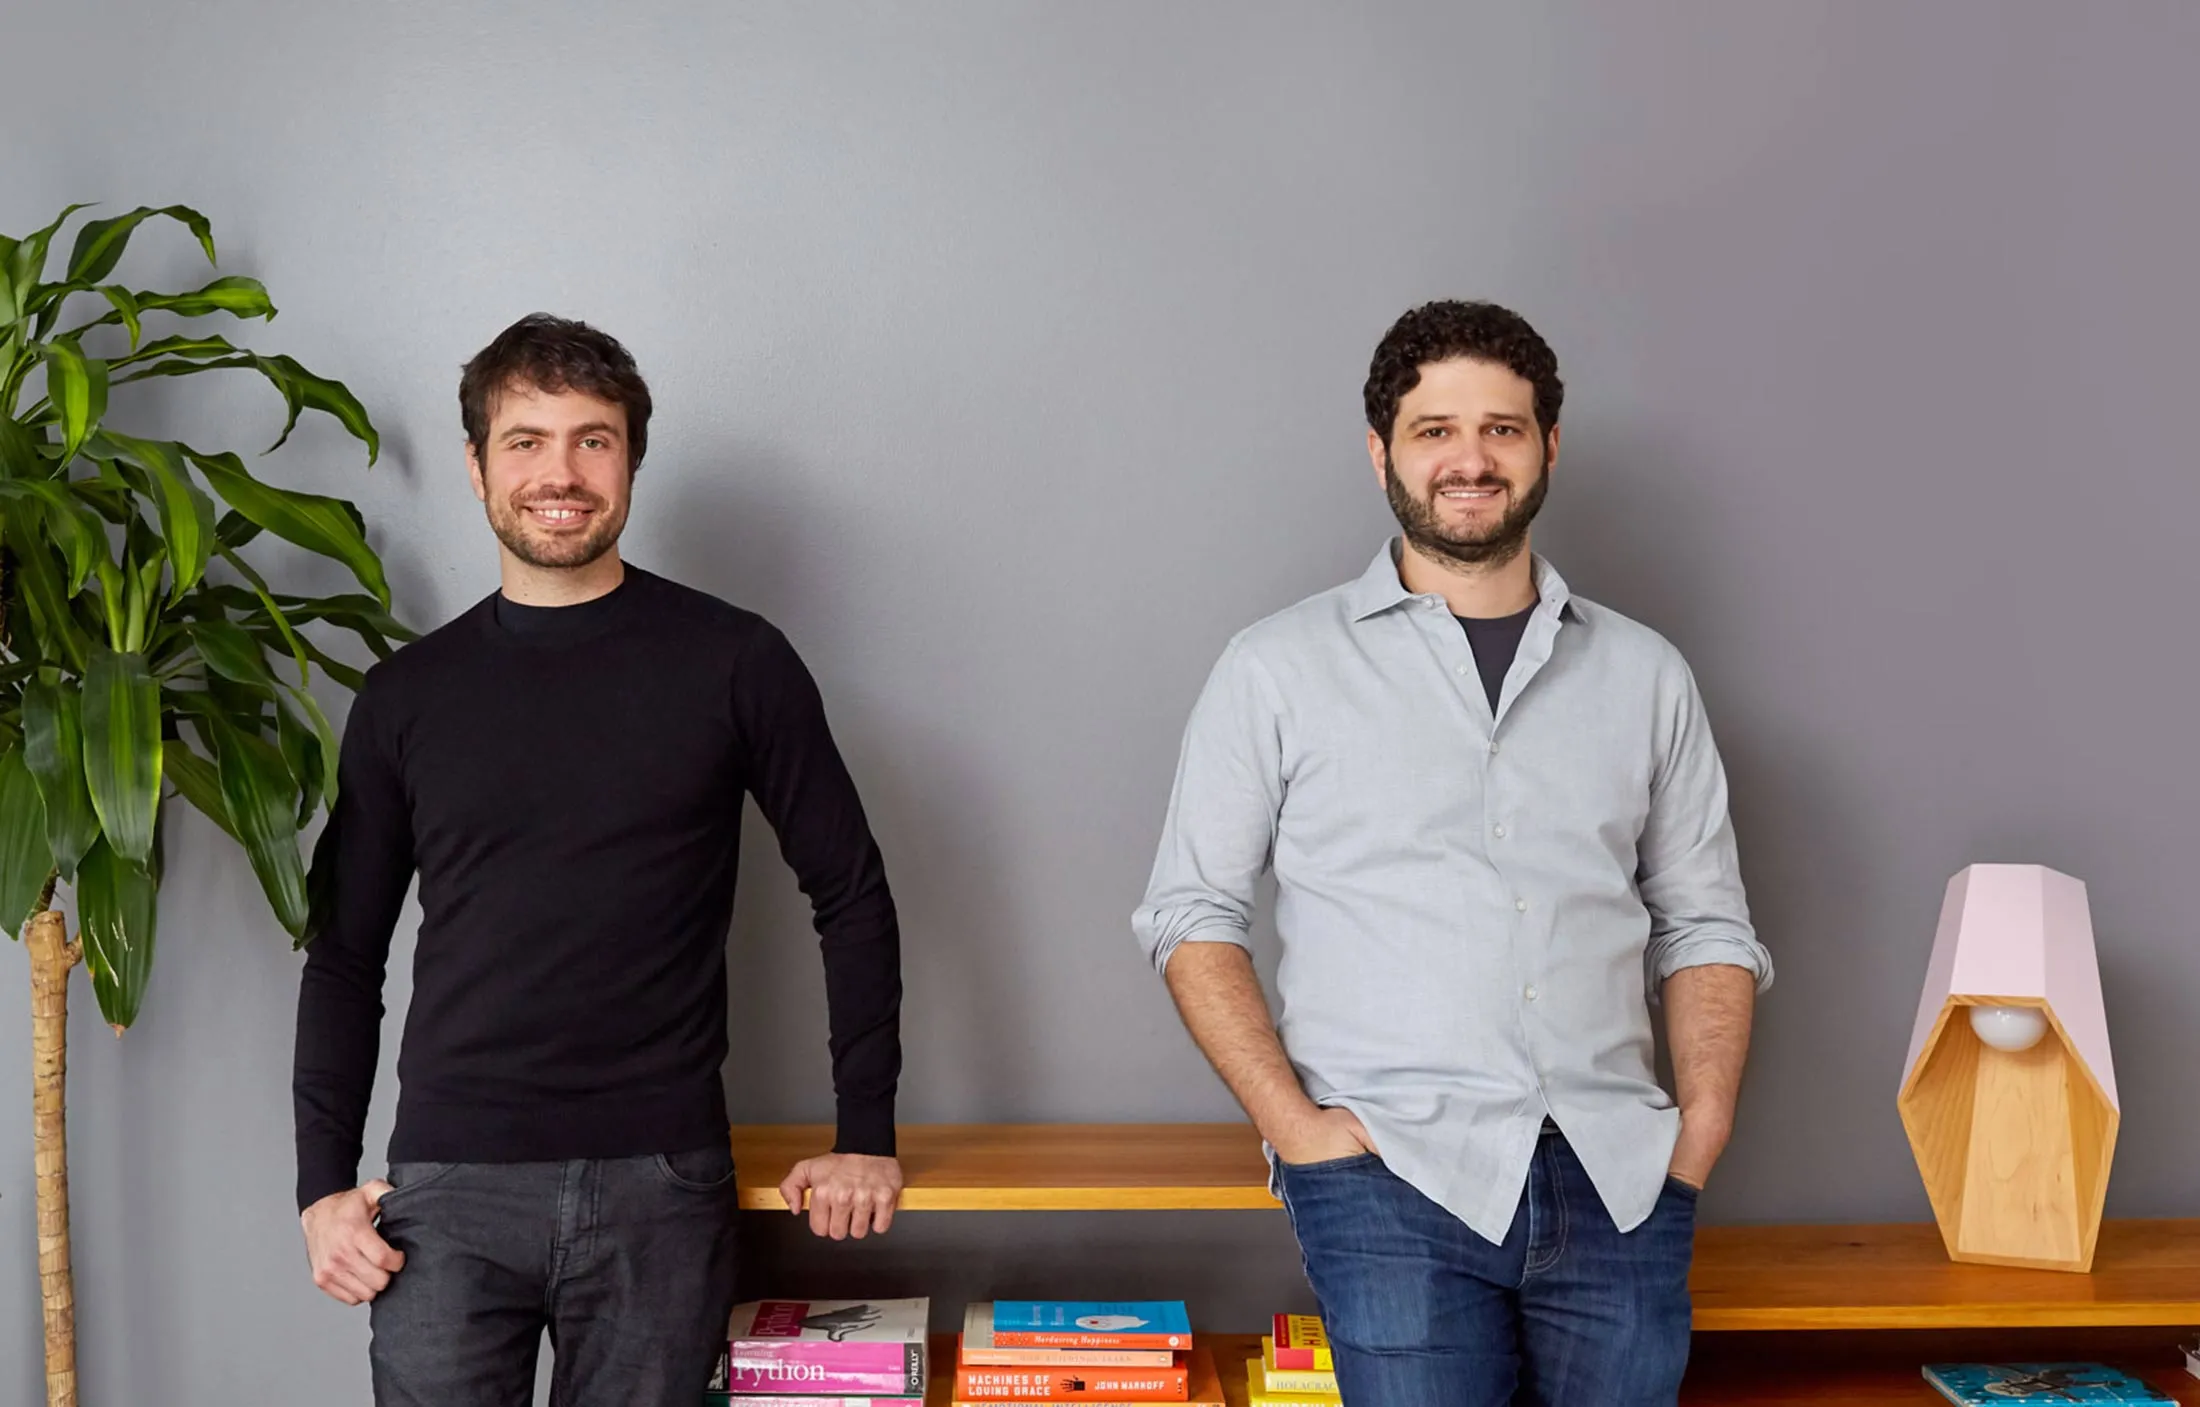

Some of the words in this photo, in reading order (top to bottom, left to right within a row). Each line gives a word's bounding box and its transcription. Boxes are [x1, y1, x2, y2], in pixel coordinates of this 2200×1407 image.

[1080, 1336, 1120, 1346] Happiness
[968, 1374, 1030, 1385] MACHINES
[1034, 1375, 1050, 1385] OF
[1094, 1380, 1119, 1390] JOHN
[1120, 1380, 1165, 1390] MARKOFF
[1276, 1380, 1334, 1391] HOLACRAC
[968, 1386, 1009, 1396] LOVING
[1014, 1386, 1051, 1396] GRACE
